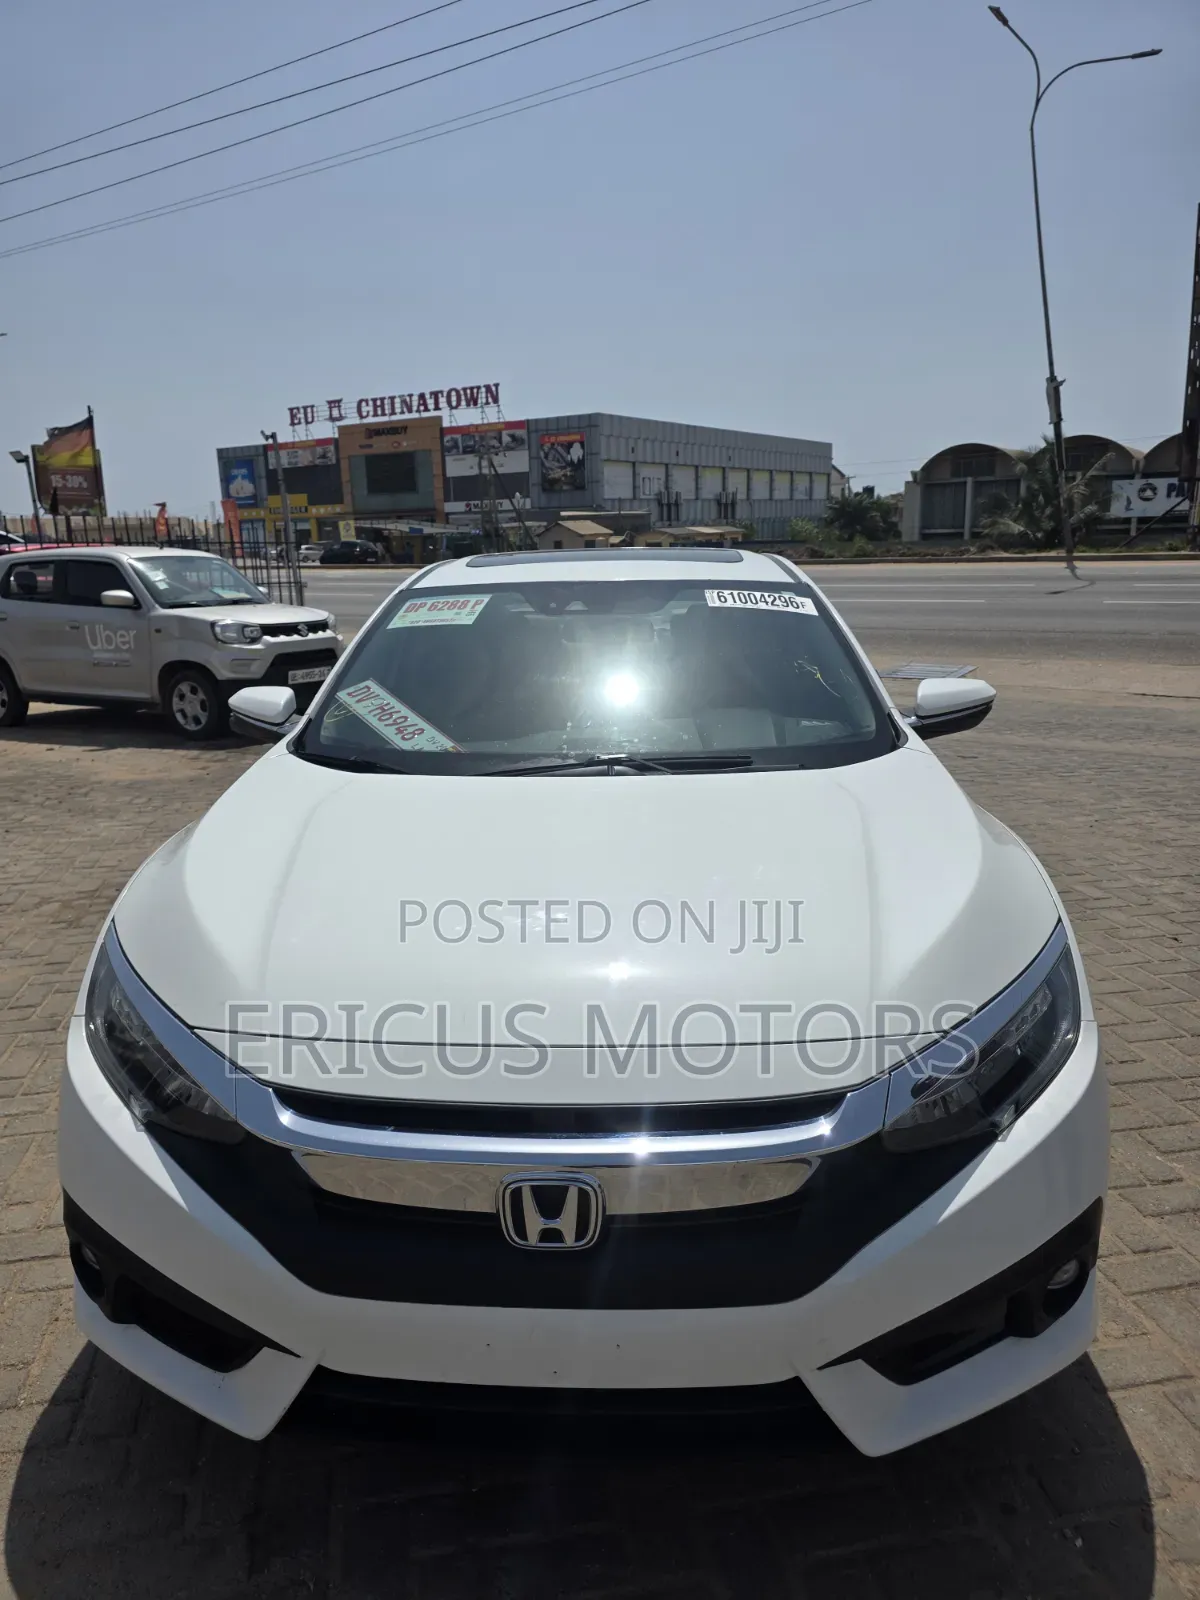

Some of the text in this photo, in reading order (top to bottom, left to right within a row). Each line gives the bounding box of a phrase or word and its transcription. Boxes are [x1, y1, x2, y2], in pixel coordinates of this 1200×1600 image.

[288, 382, 501, 427] EU CHINATOWN
[427, 599, 471, 612] 6288
[716, 590, 800, 610] 61004296
[84, 624, 137, 650] Uber
